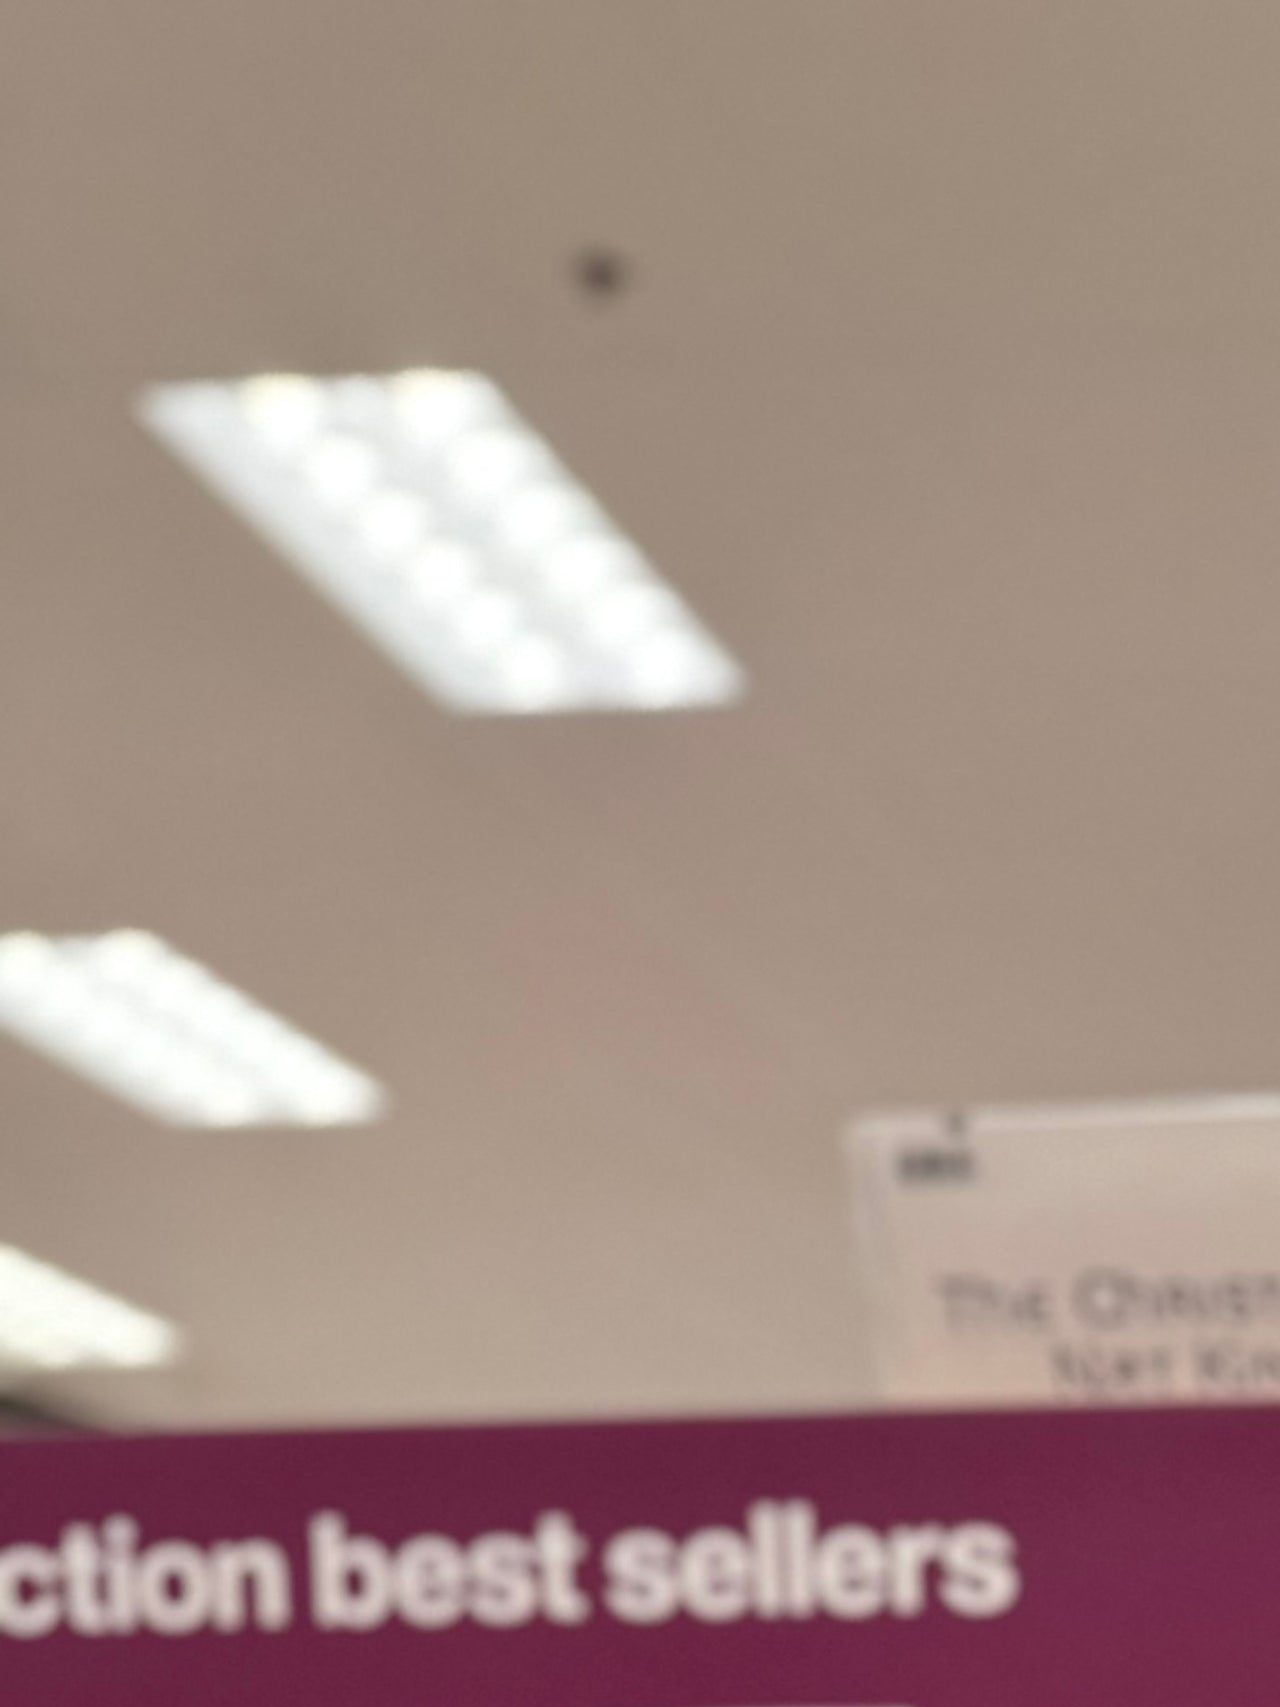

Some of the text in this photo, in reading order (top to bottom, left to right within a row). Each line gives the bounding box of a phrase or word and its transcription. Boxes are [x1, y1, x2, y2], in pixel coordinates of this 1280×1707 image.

[0, 1495, 1021, 1638] ction best sellers
